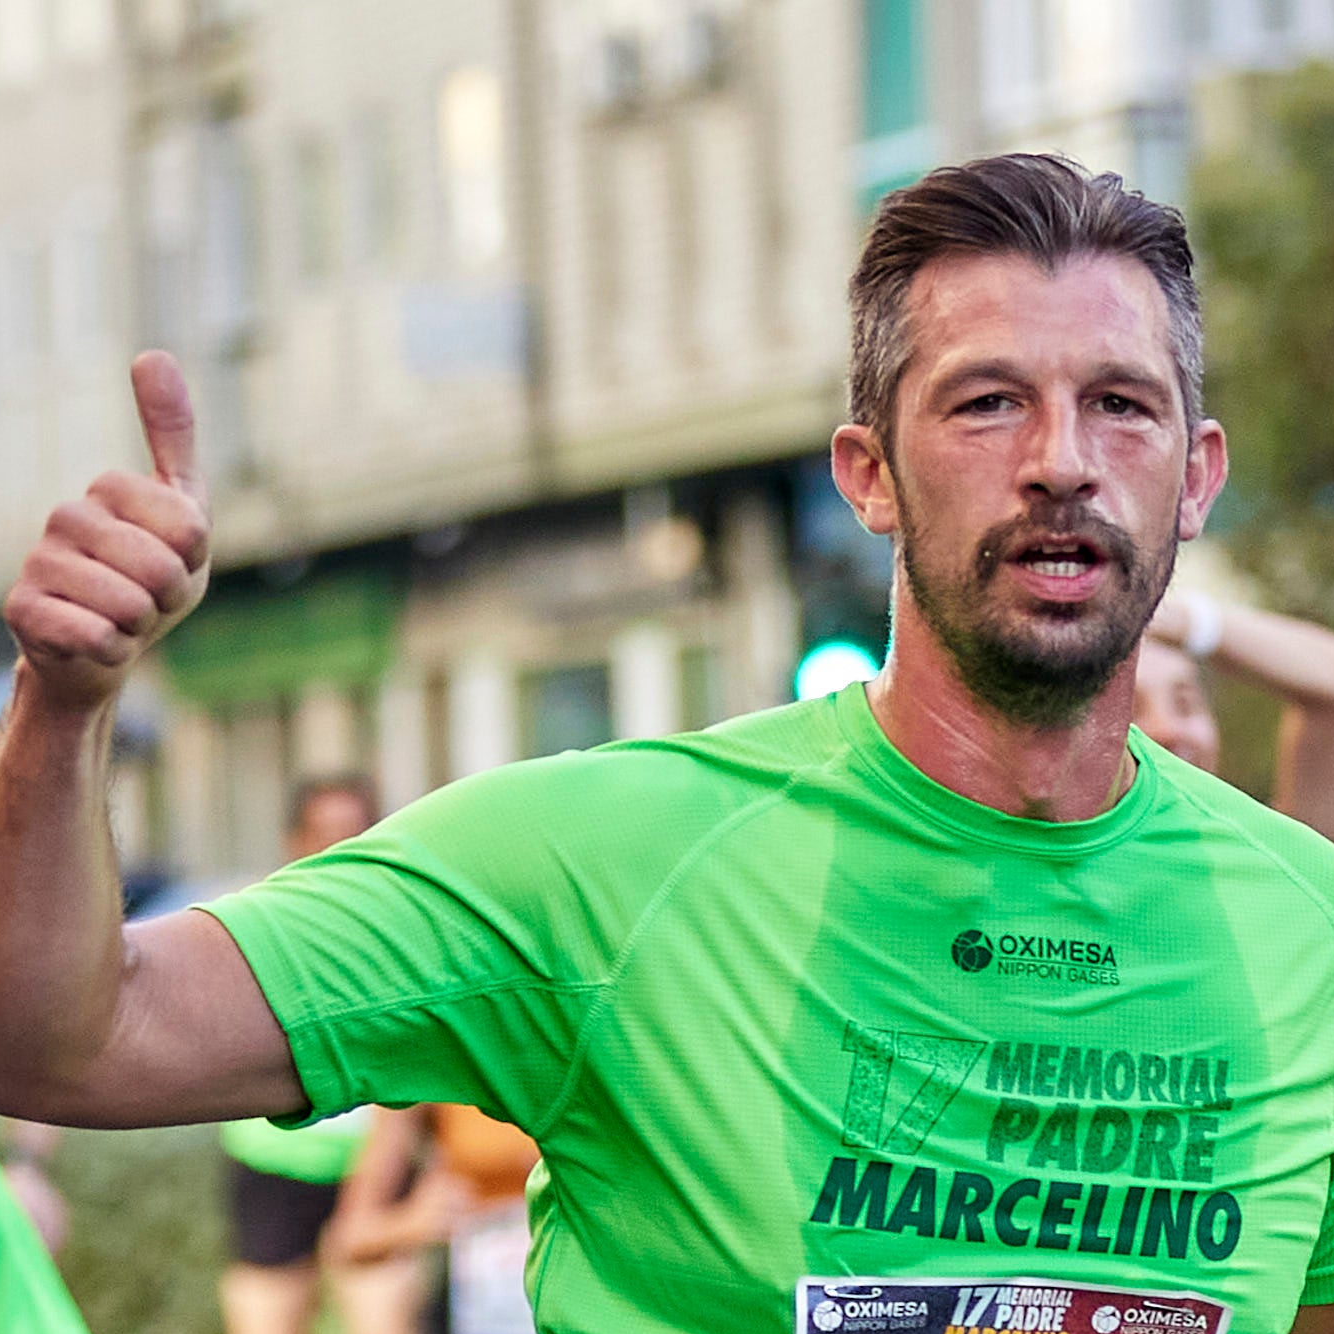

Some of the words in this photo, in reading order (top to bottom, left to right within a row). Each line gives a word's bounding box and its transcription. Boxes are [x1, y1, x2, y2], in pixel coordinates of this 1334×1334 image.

[999, 934, 1116, 967] OXIMESA
[997, 961, 1062, 980] NIPPON
[1067, 967, 1120, 986] GASES
[841, 1020, 988, 1155] 17
[985, 1040, 1234, 1111] MEMORIAL
[985, 1098, 1219, 1183] PADRE
[809, 1157, 1242, 1261] MARCELINO
[844, 1301, 928, 1318] OXIMESA
[951, 1287, 997, 1327] 17
[995, 1286, 1073, 1307] MEMORIAL
[994, 1304, 1066, 1331] PADRE
[1123, 1308, 1208, 1329] OXIMESA
